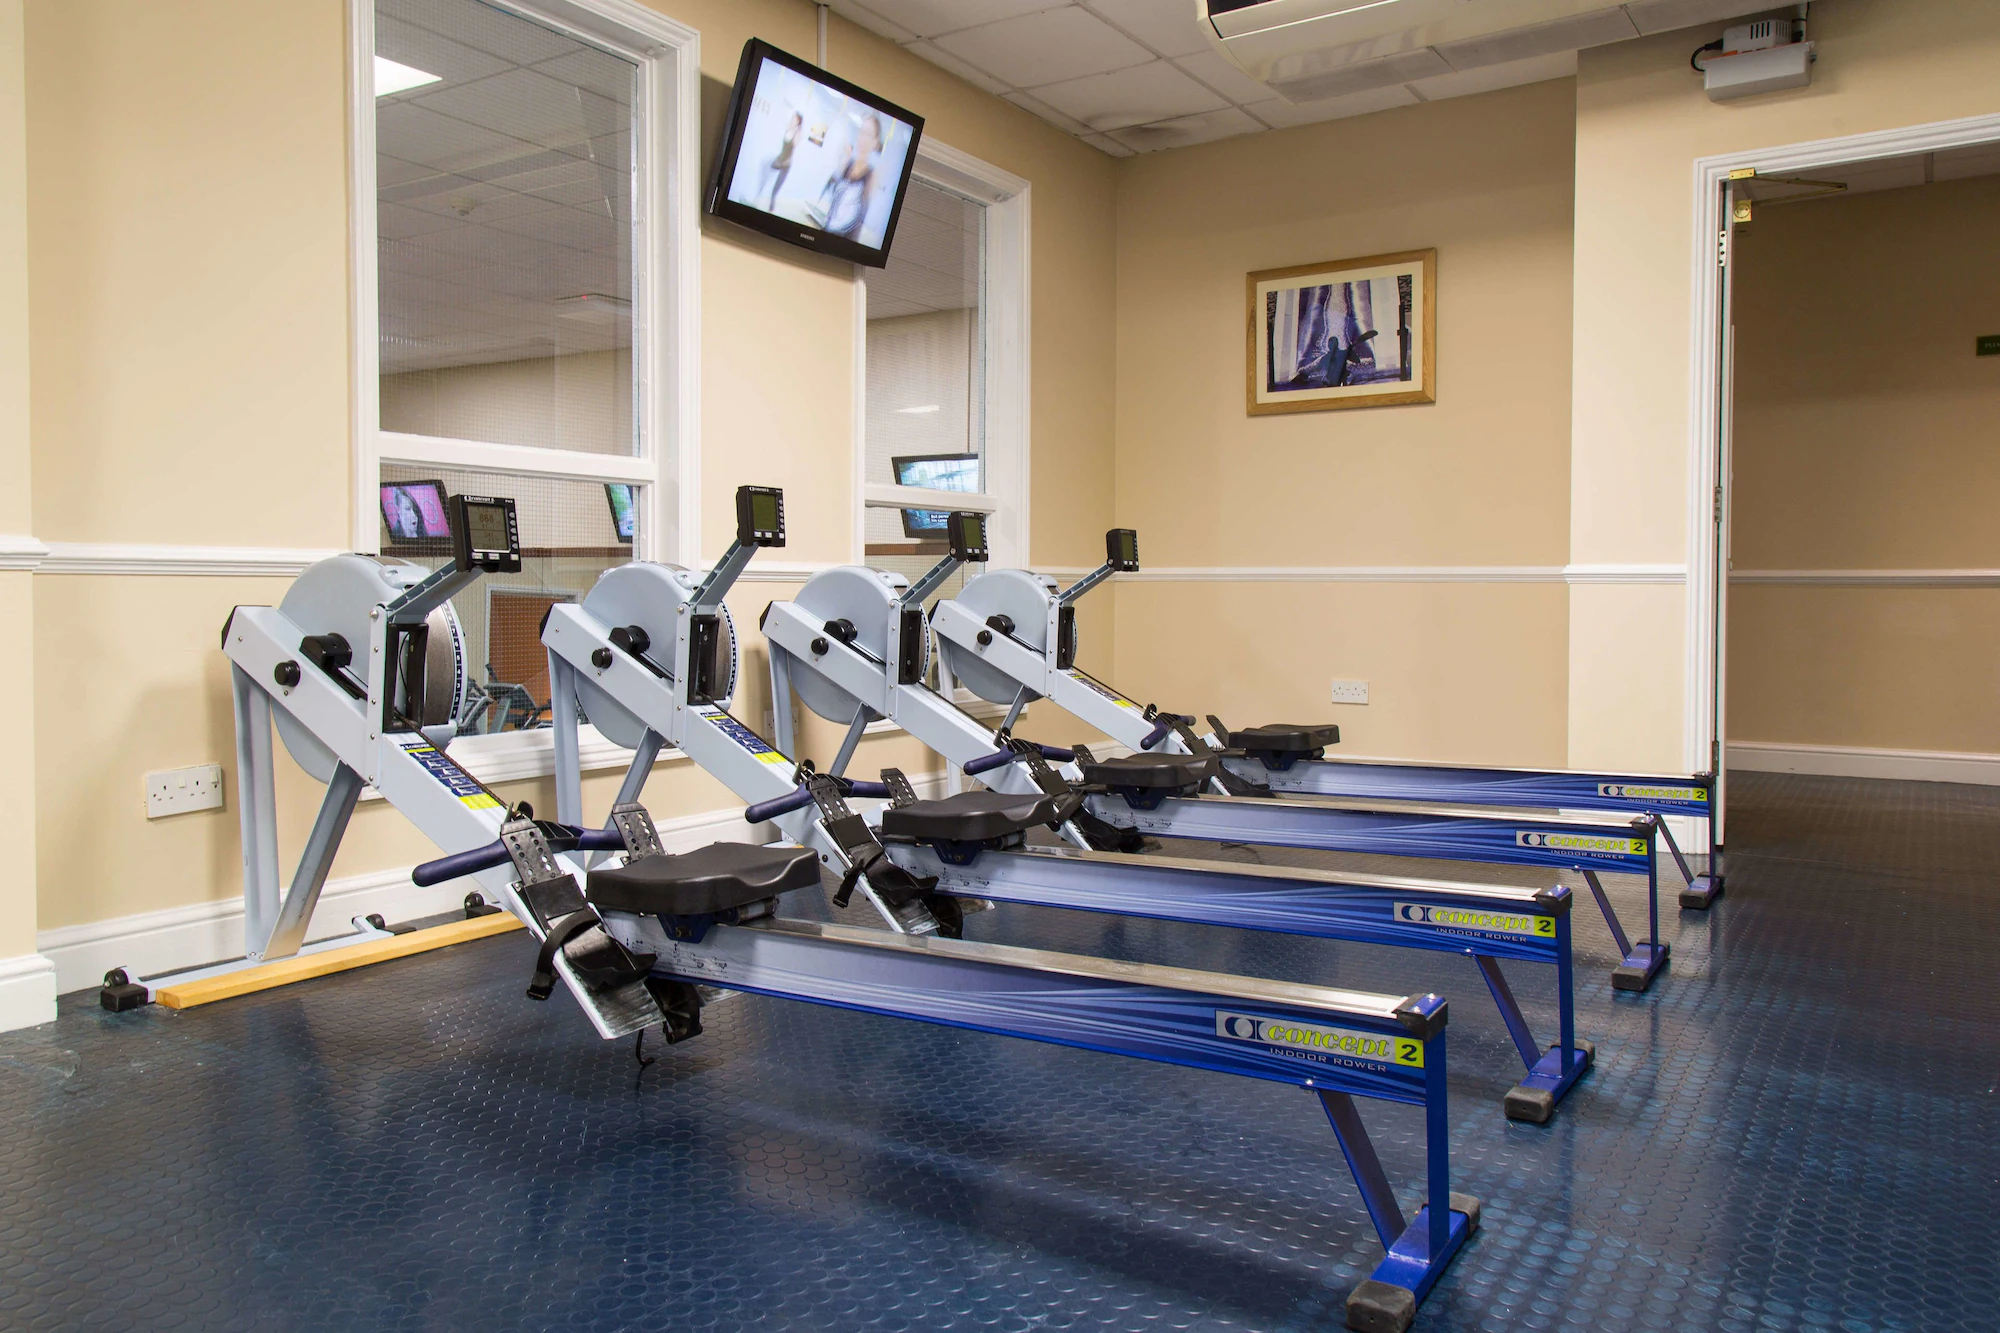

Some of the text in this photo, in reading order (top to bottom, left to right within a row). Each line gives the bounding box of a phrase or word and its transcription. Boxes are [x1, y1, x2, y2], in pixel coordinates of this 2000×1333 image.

[1626, 787, 1705, 799] concept 2
[1550, 836, 1644, 852] concept 2
[1551, 849, 1625, 860] INDOOR ROWER
[1435, 909, 1551, 933] concept 2
[1436, 927, 1528, 943] INDOOR ROWER
[1268, 1024, 1418, 1062] concept 2
[1270, 1047, 1387, 1072] INDOOR ROWER
